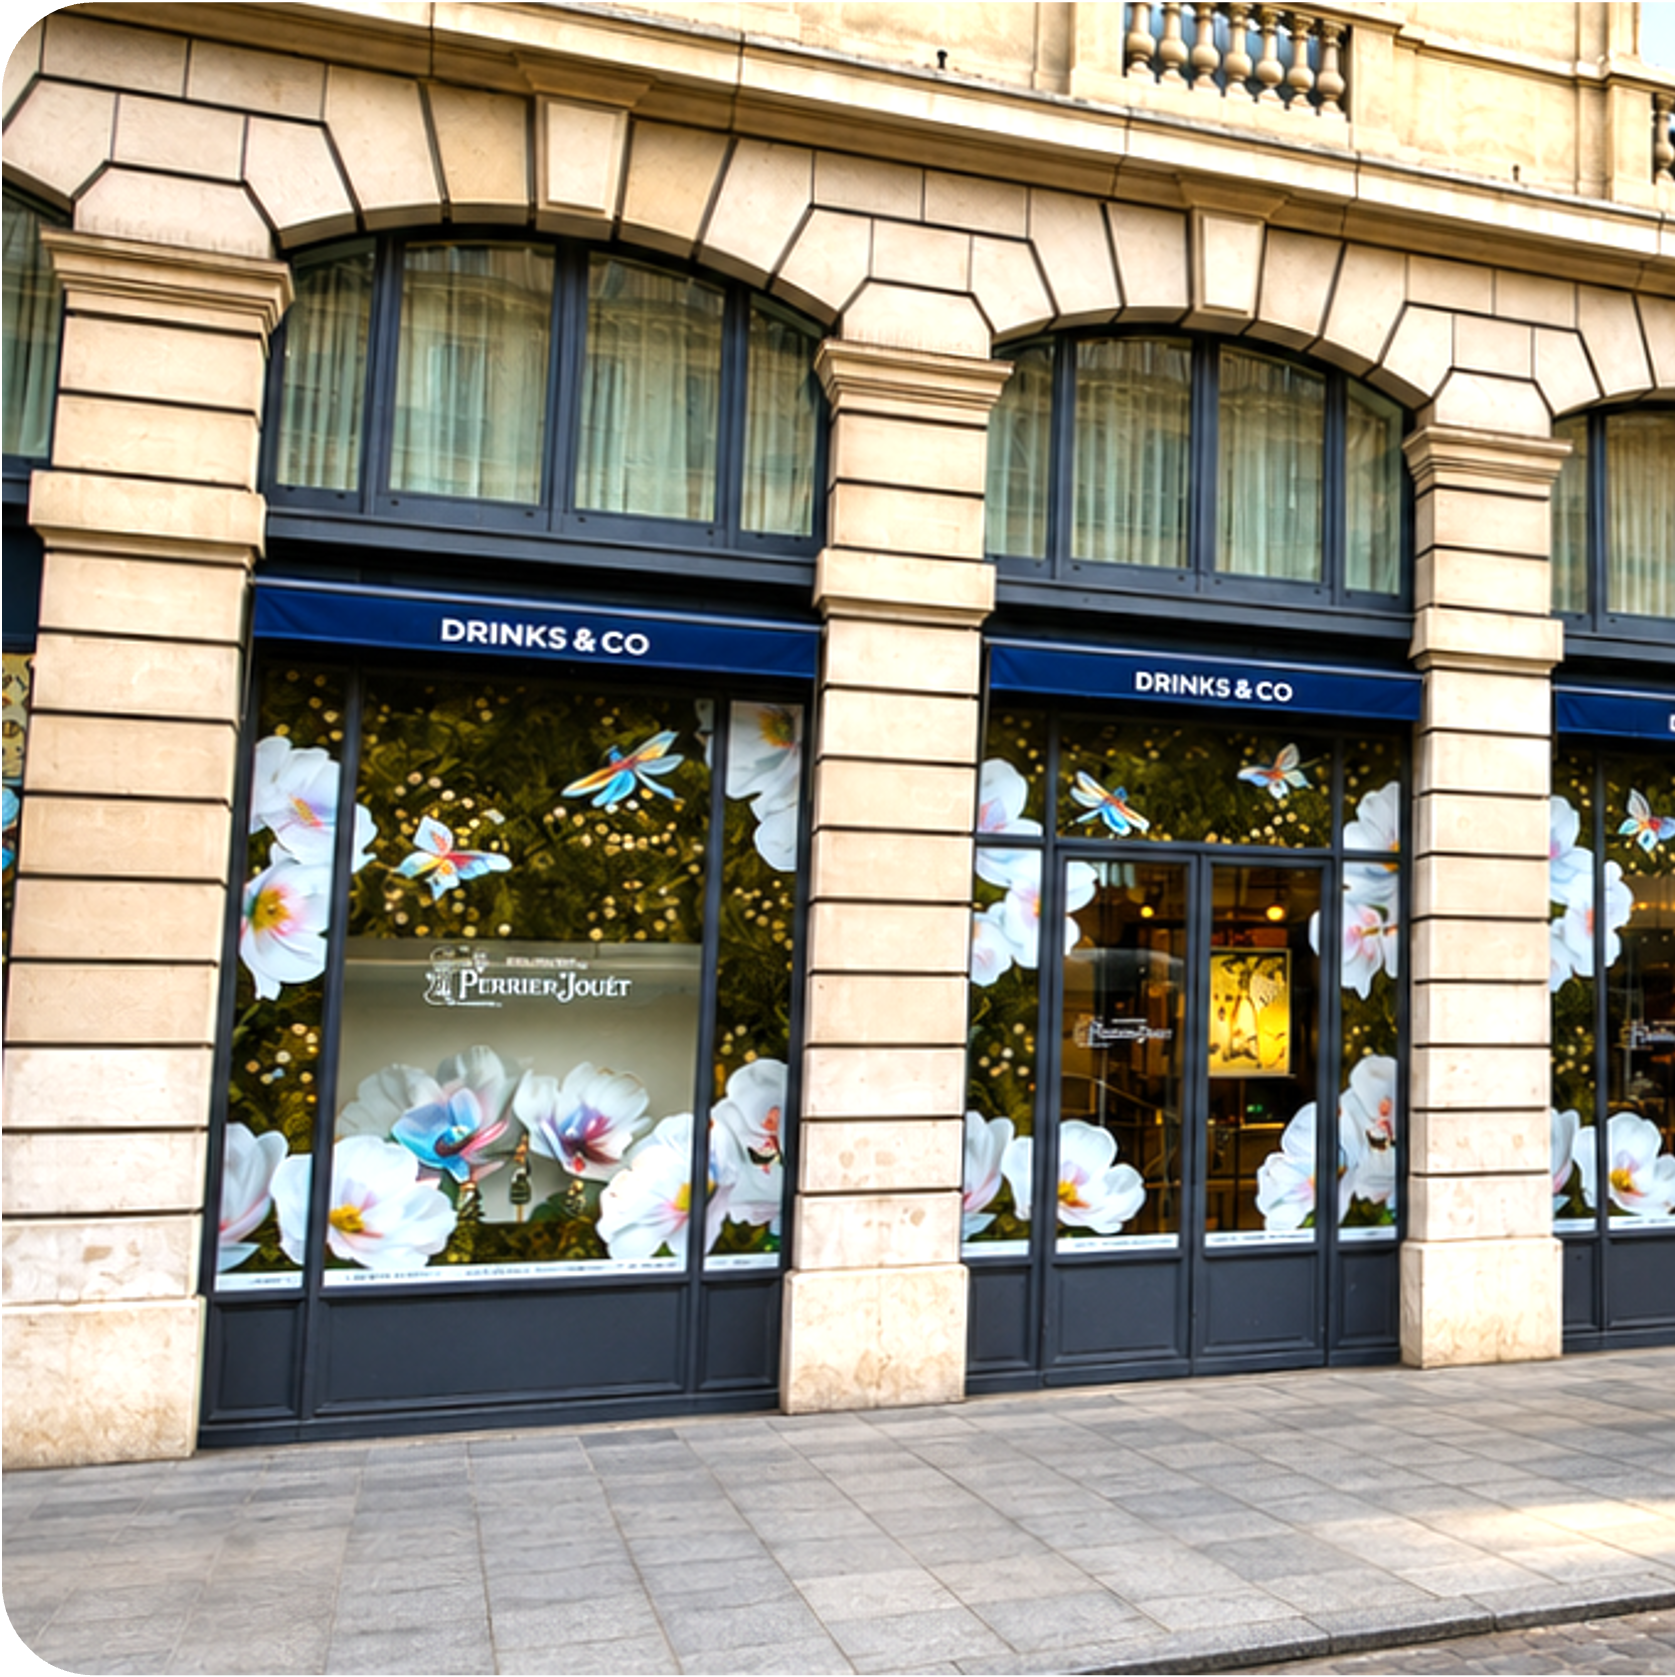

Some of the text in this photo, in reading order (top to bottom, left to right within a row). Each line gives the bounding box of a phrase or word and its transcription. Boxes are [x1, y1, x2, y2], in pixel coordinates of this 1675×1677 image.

[441, 617, 650, 656] DRINKS & CO
[1135, 671, 1294, 702] DRINKS & CO
